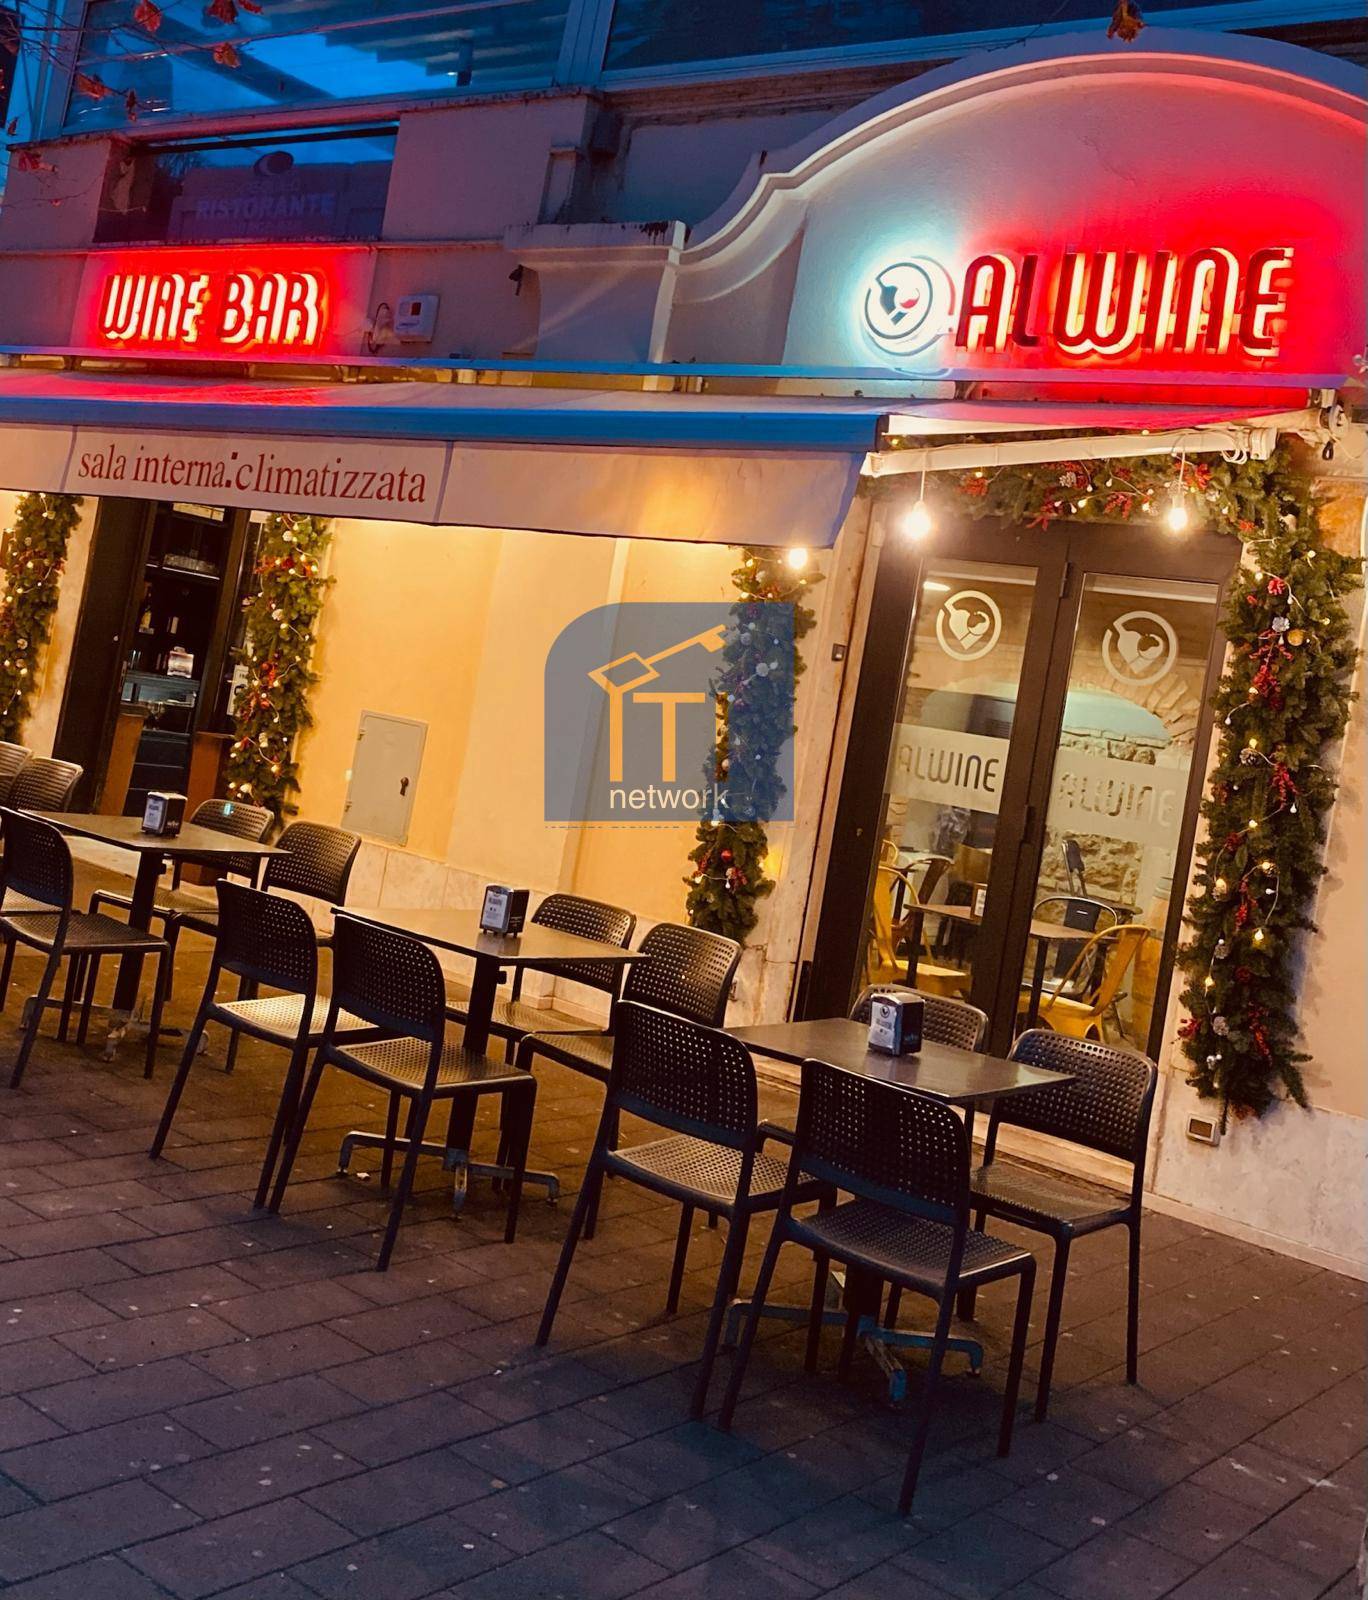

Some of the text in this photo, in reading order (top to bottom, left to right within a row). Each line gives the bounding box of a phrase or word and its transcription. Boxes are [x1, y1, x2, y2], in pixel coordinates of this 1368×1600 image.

[99, 272, 320, 345] WINE BAR
[955, 247, 1294, 357] ALWINE
[78, 444, 126, 480] sala
[895, 744, 1000, 793] ALWINE
[1060, 772, 1178, 827] ALWINE
